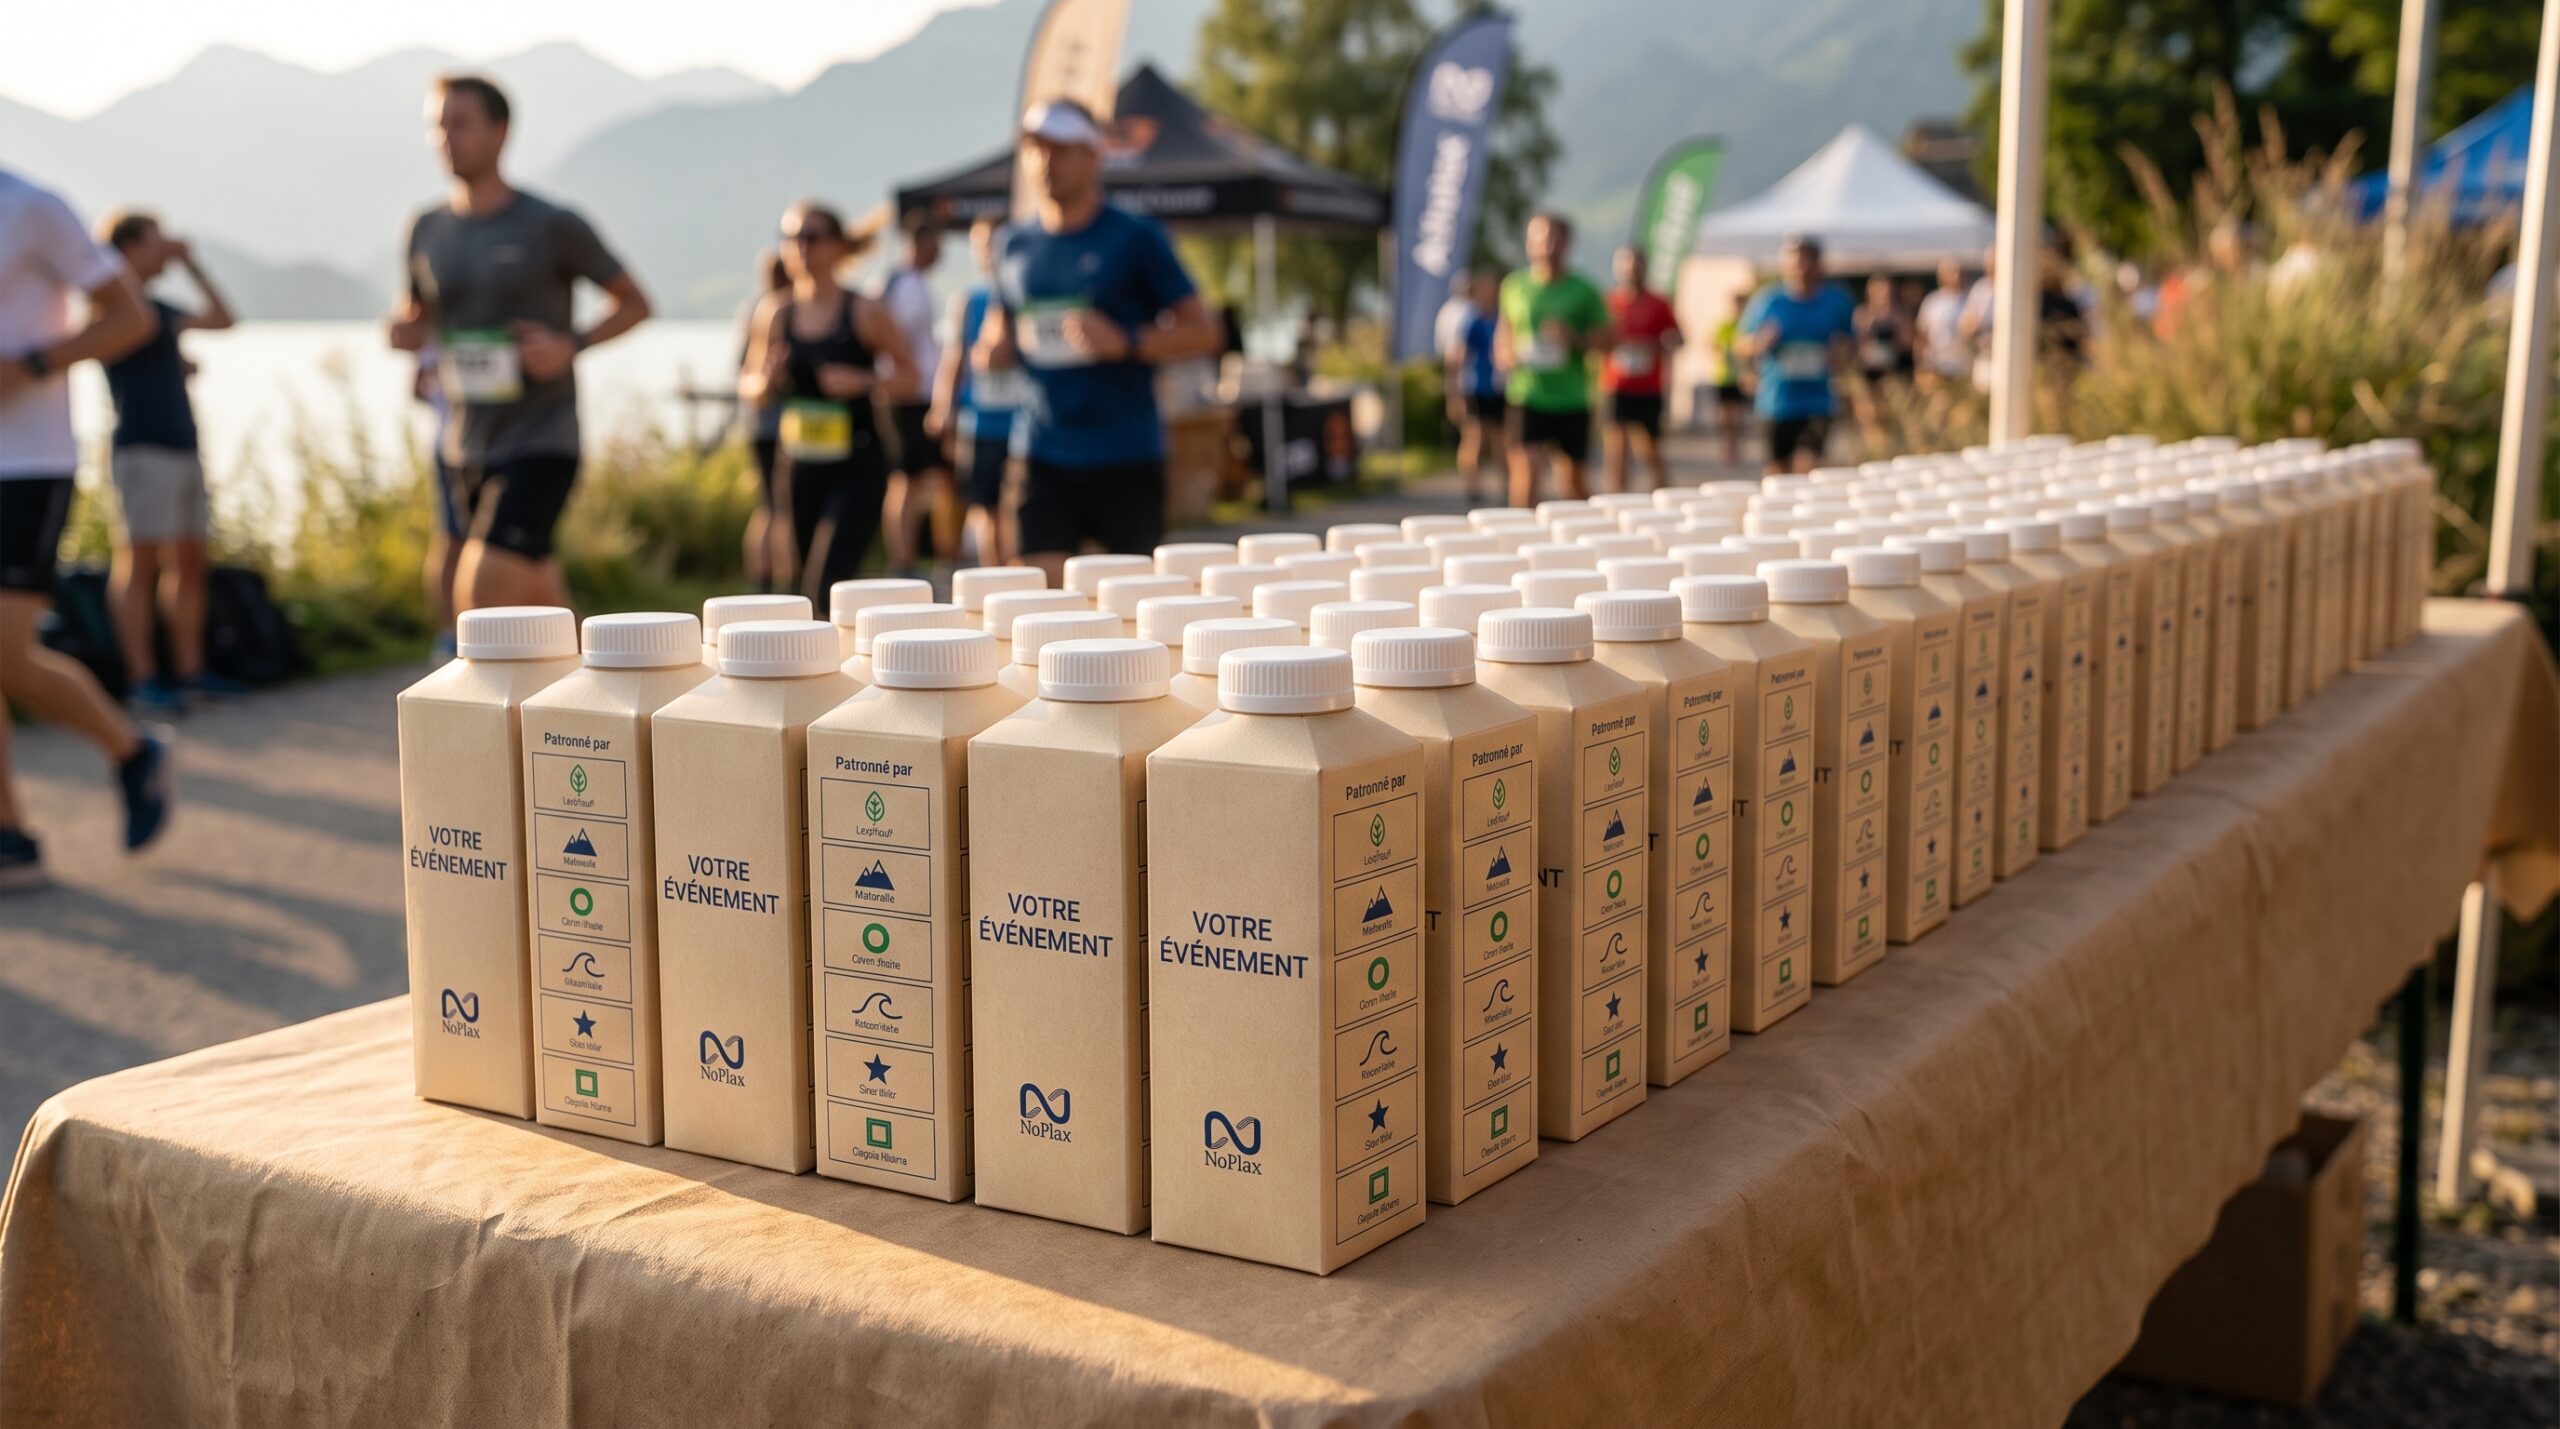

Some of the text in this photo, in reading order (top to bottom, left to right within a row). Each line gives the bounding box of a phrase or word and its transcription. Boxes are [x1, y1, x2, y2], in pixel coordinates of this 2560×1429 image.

[1592, 714, 1637, 736] Patronné par
[544, 732, 611, 752] Patronné par
[1472, 742, 1524, 767] Patronné par
[835, 755, 913, 778] Patronné par
[1346, 774, 1407, 800] Patronné par
[429, 825, 483, 850] VOTRE
[410, 846, 508, 880] ÉVÉNEMENT
[688, 854, 751, 882] VOTRE
[664, 876, 780, 915] ÉVÉNEMENT
[1008, 892, 1081, 923] VOTRE
[979, 915, 1114, 958] ÉVÉNEMENT
[1192, 910, 1273, 942] VOTRE
[1160, 935, 1309, 979] ÉVÉNEMENT
[442, 1020, 481, 1040] NoPlax
[700, 1064, 747, 1088] NoPlax
[1020, 1118, 1072, 1143] NoPlax
[1204, 1149, 1263, 1176] NoPlax
